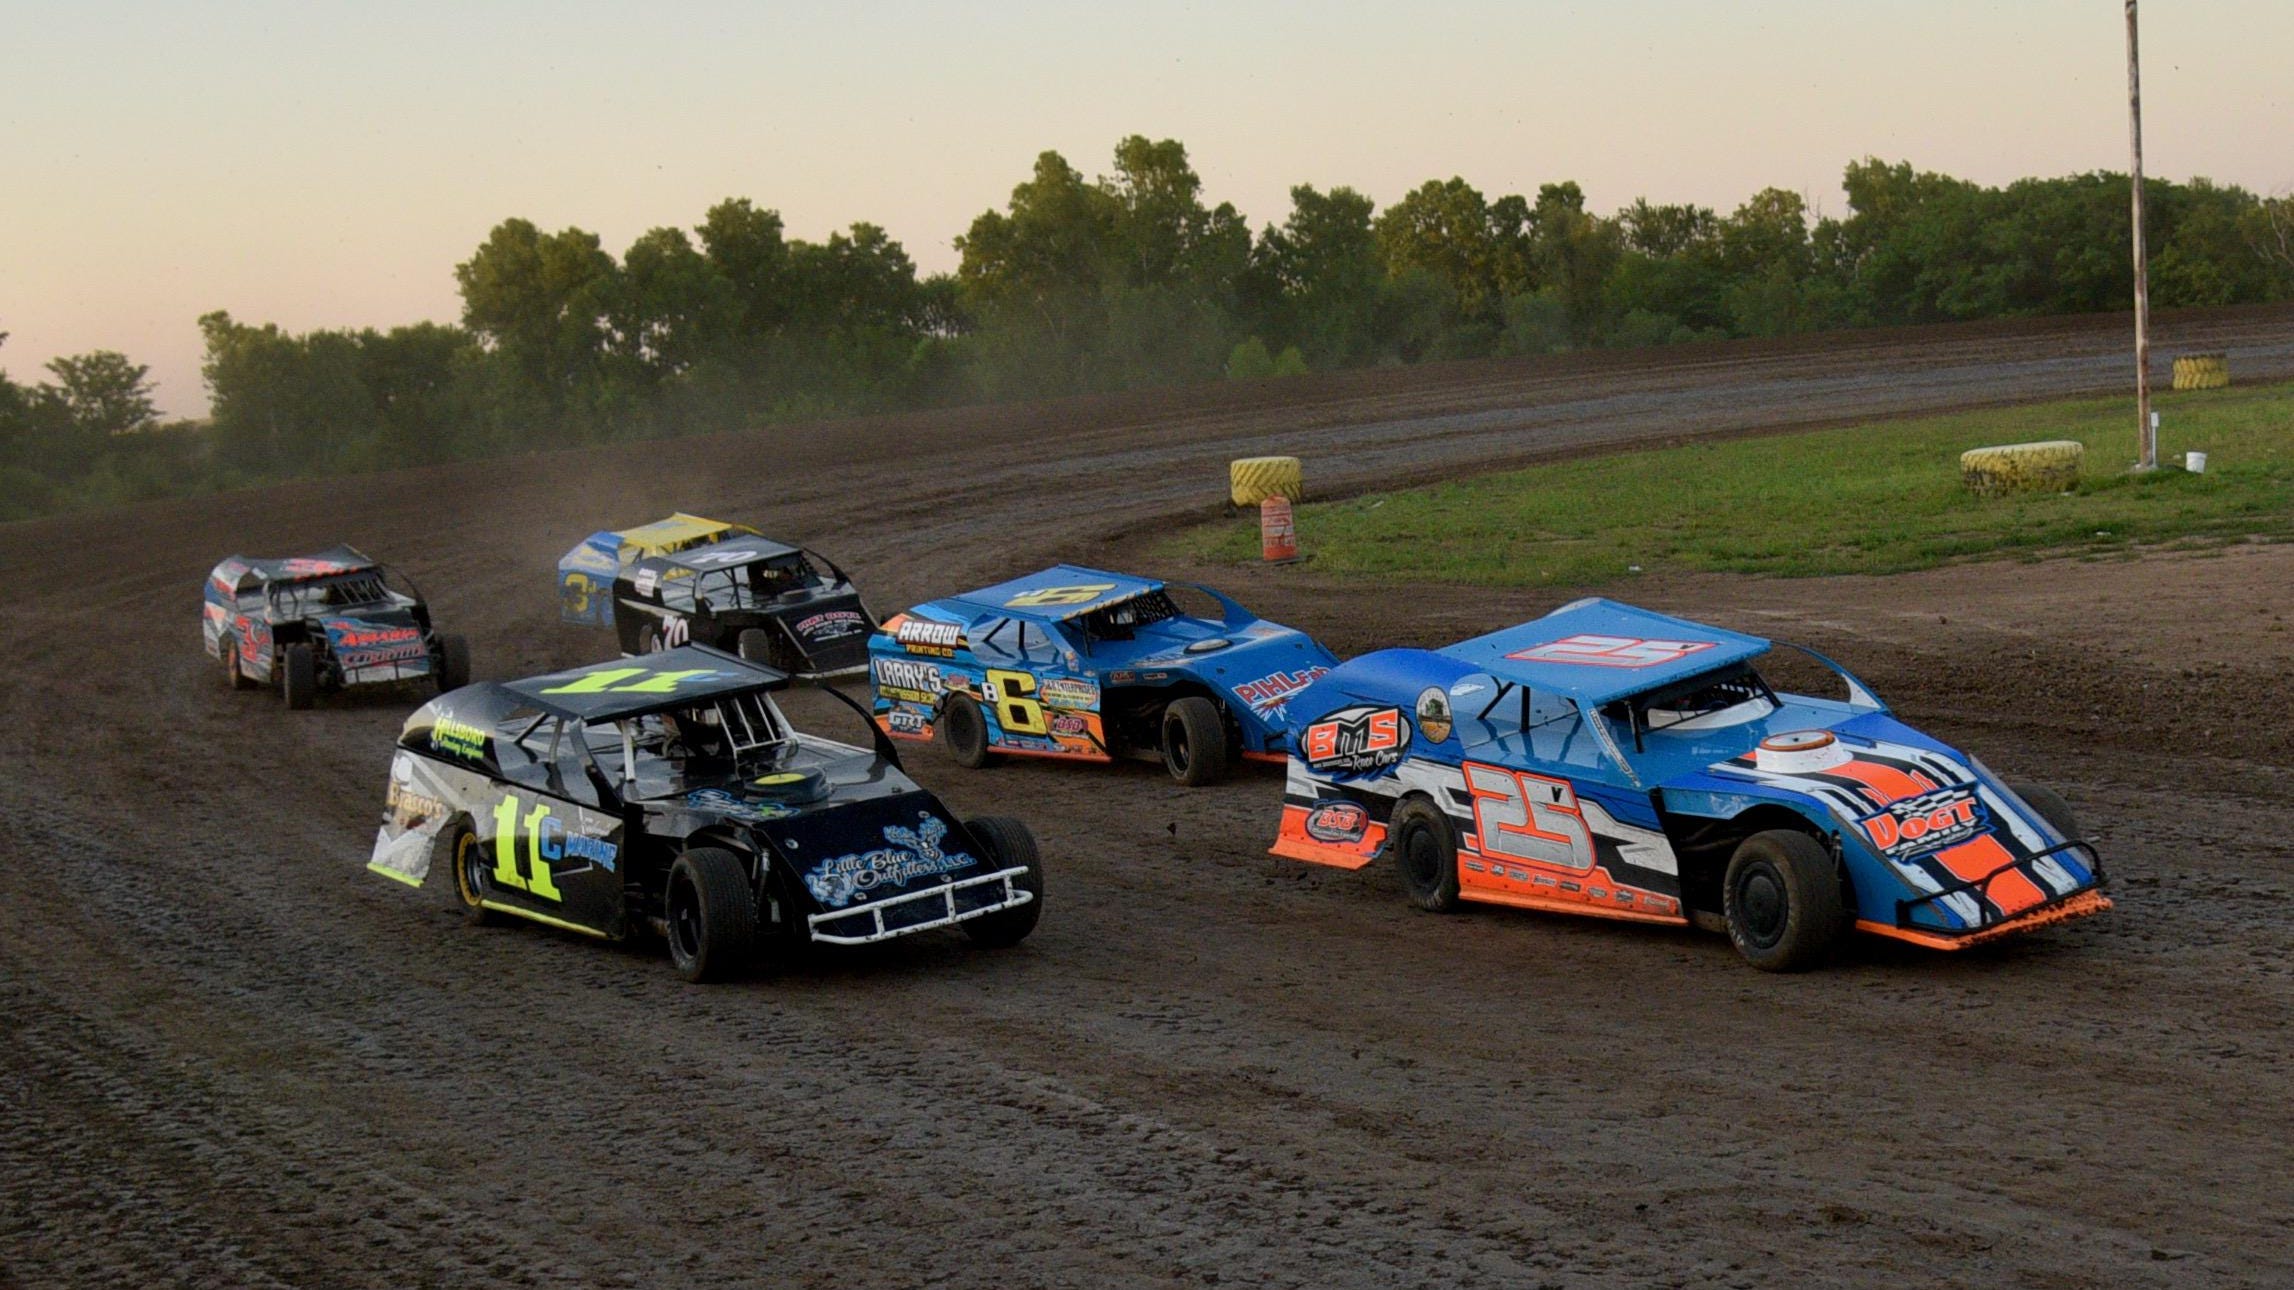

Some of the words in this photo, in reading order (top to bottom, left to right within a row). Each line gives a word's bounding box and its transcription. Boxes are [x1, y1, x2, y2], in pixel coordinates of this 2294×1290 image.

[898, 621, 961, 647] ARROW
[874, 659, 942, 693] LARRY'S
[1307, 708, 1400, 762] BMS
[387, 778, 445, 821] Brasco's
[1461, 760, 1597, 878] 25
[1861, 796, 1978, 851] VOGT
[1885, 818, 1979, 856] FAMILY
[863, 850, 914, 871] Blue
